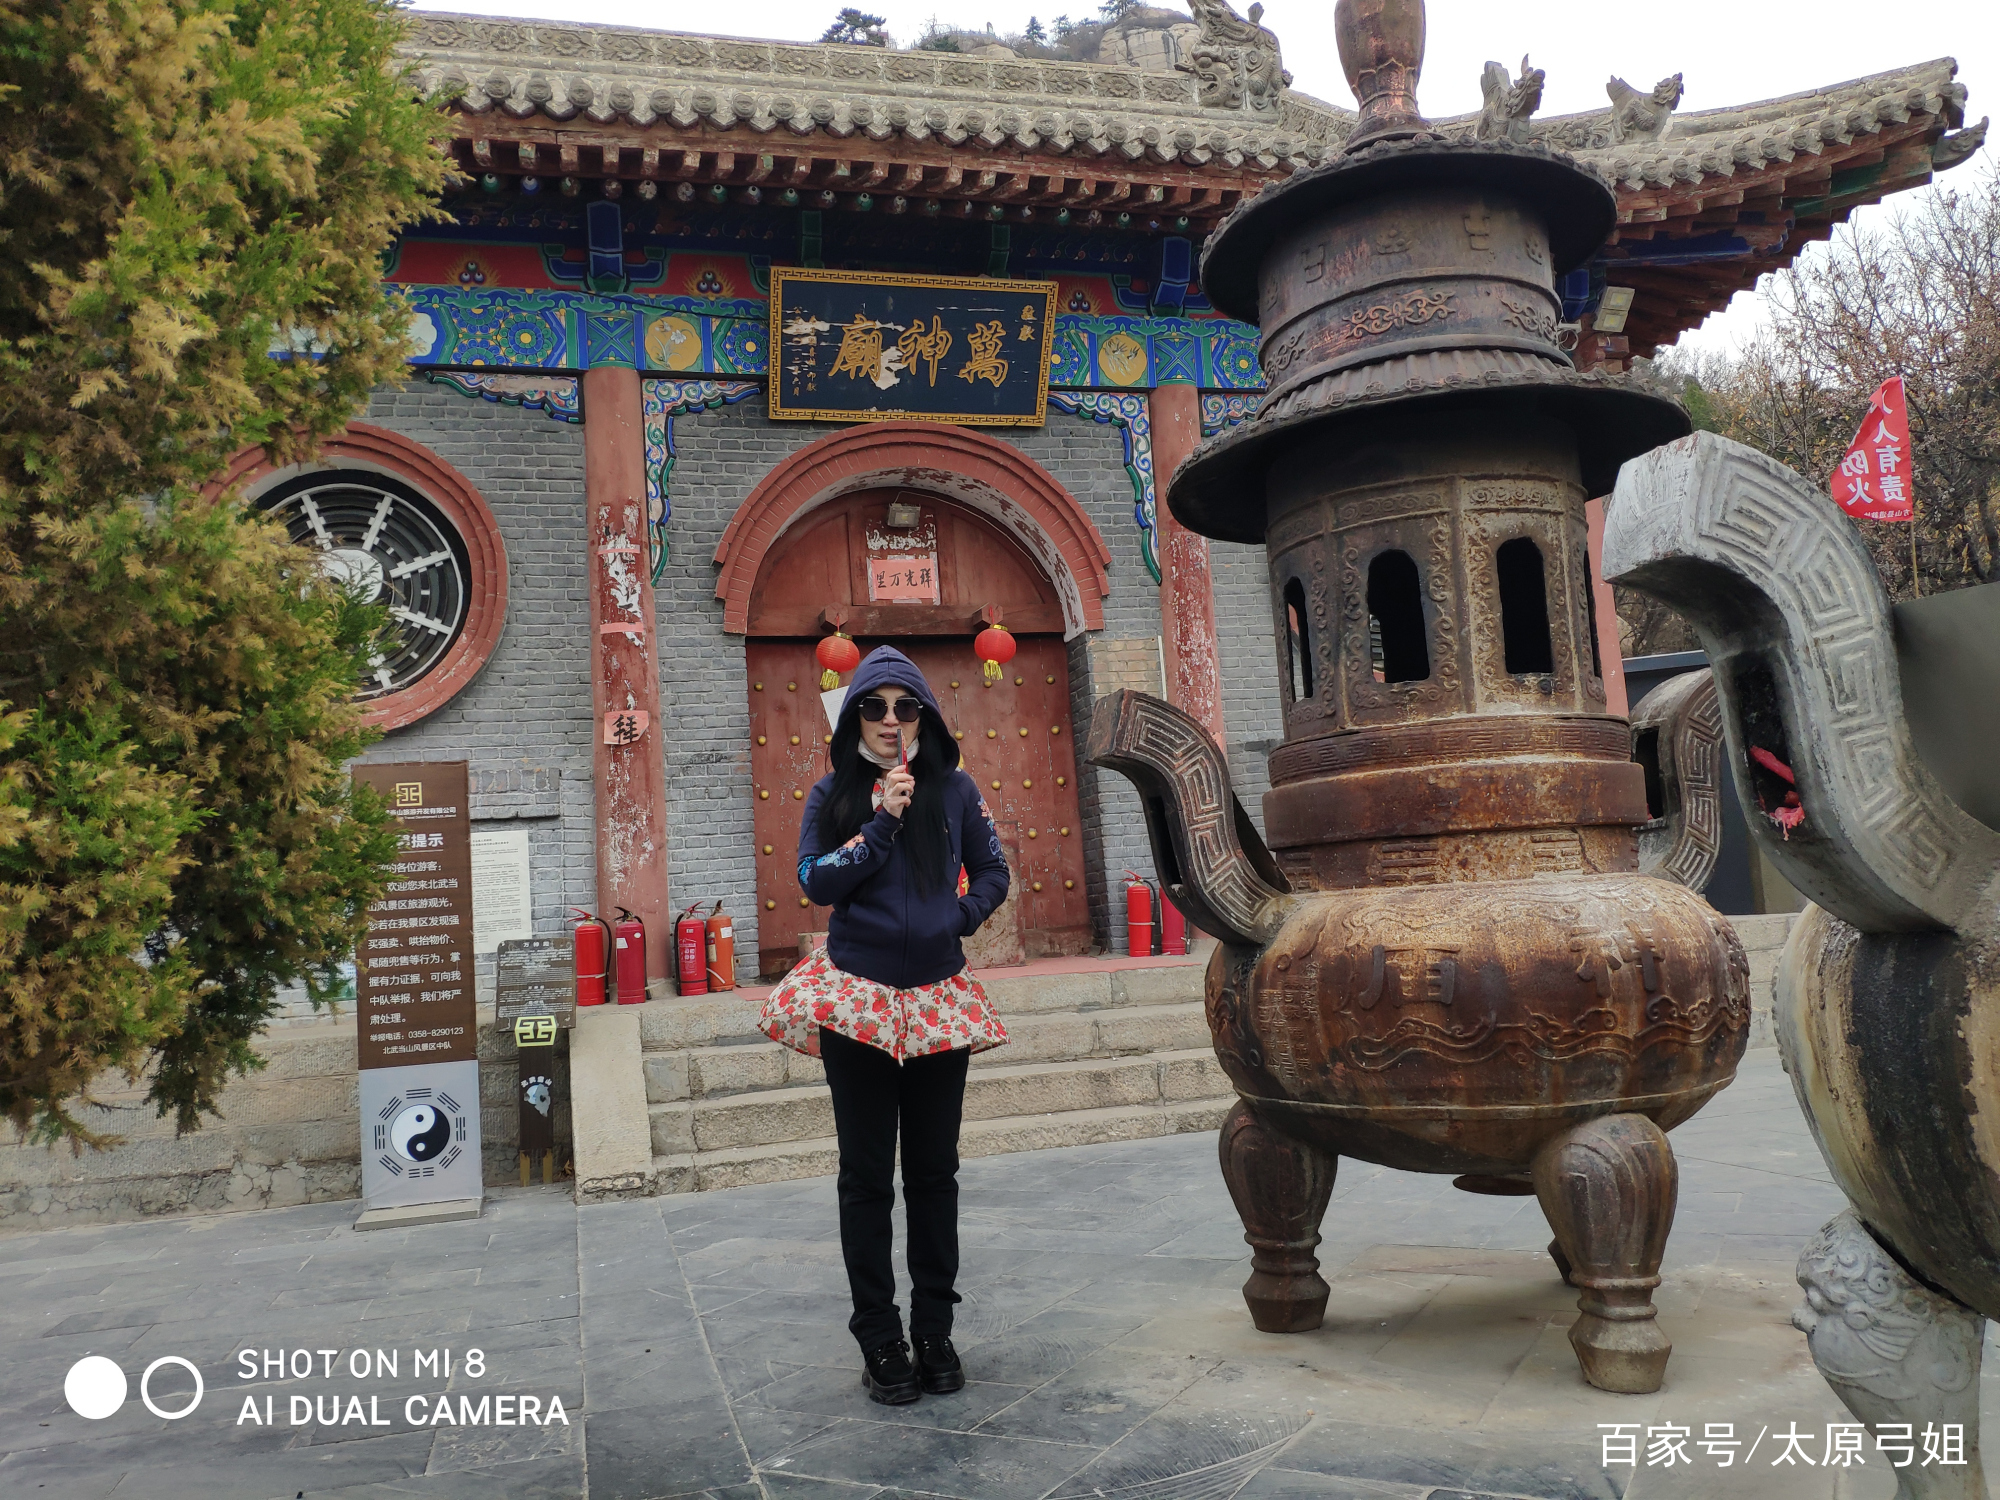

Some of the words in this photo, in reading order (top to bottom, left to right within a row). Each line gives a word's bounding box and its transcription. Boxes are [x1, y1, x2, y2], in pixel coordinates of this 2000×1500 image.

[386, 878, 458, 892] 欢迎您来北武当
[368, 914, 459, 931] 您若在我景区发现强
[382, 1041, 452, 1055] 北武当山风景区中队
